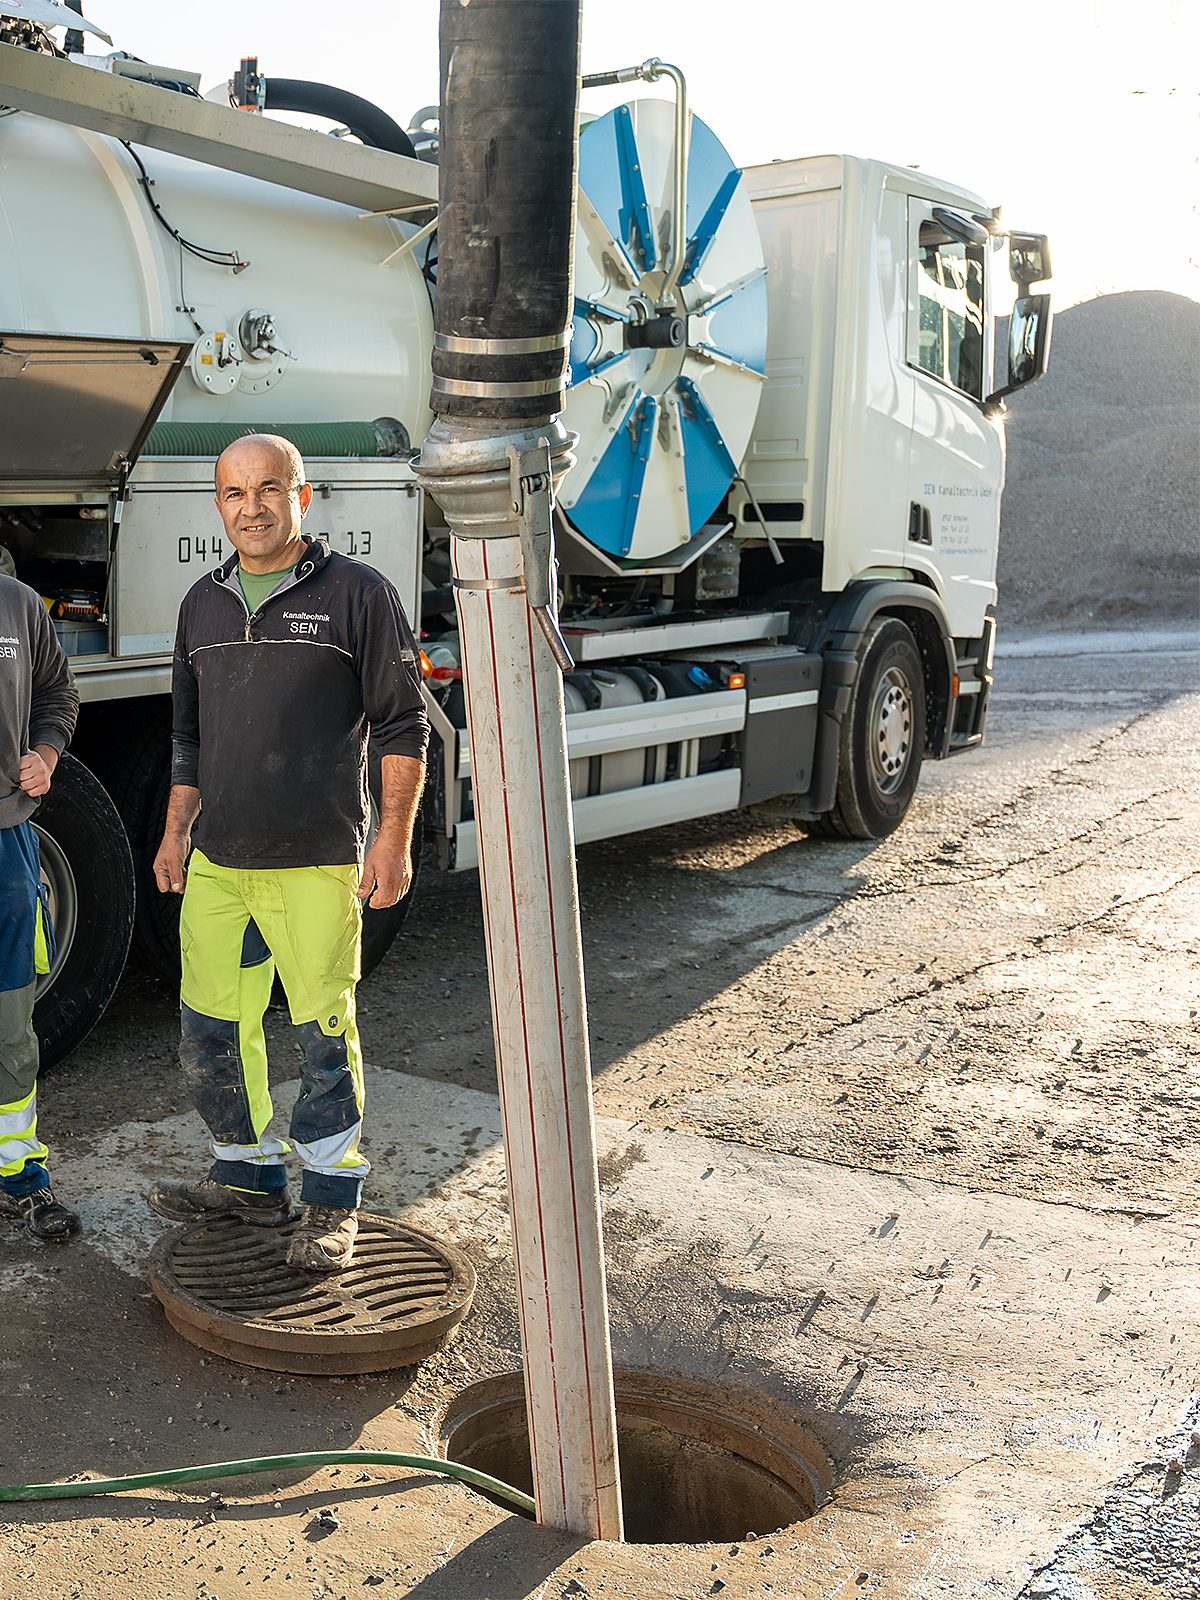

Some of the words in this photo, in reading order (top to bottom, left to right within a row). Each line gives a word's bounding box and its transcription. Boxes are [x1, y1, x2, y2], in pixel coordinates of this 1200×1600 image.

[178, 535, 223, 563] 044
[347, 531, 371, 555] 13
[282, 611, 330, 622] Kanaltechnik
[289, 621, 319, 635] SEN
